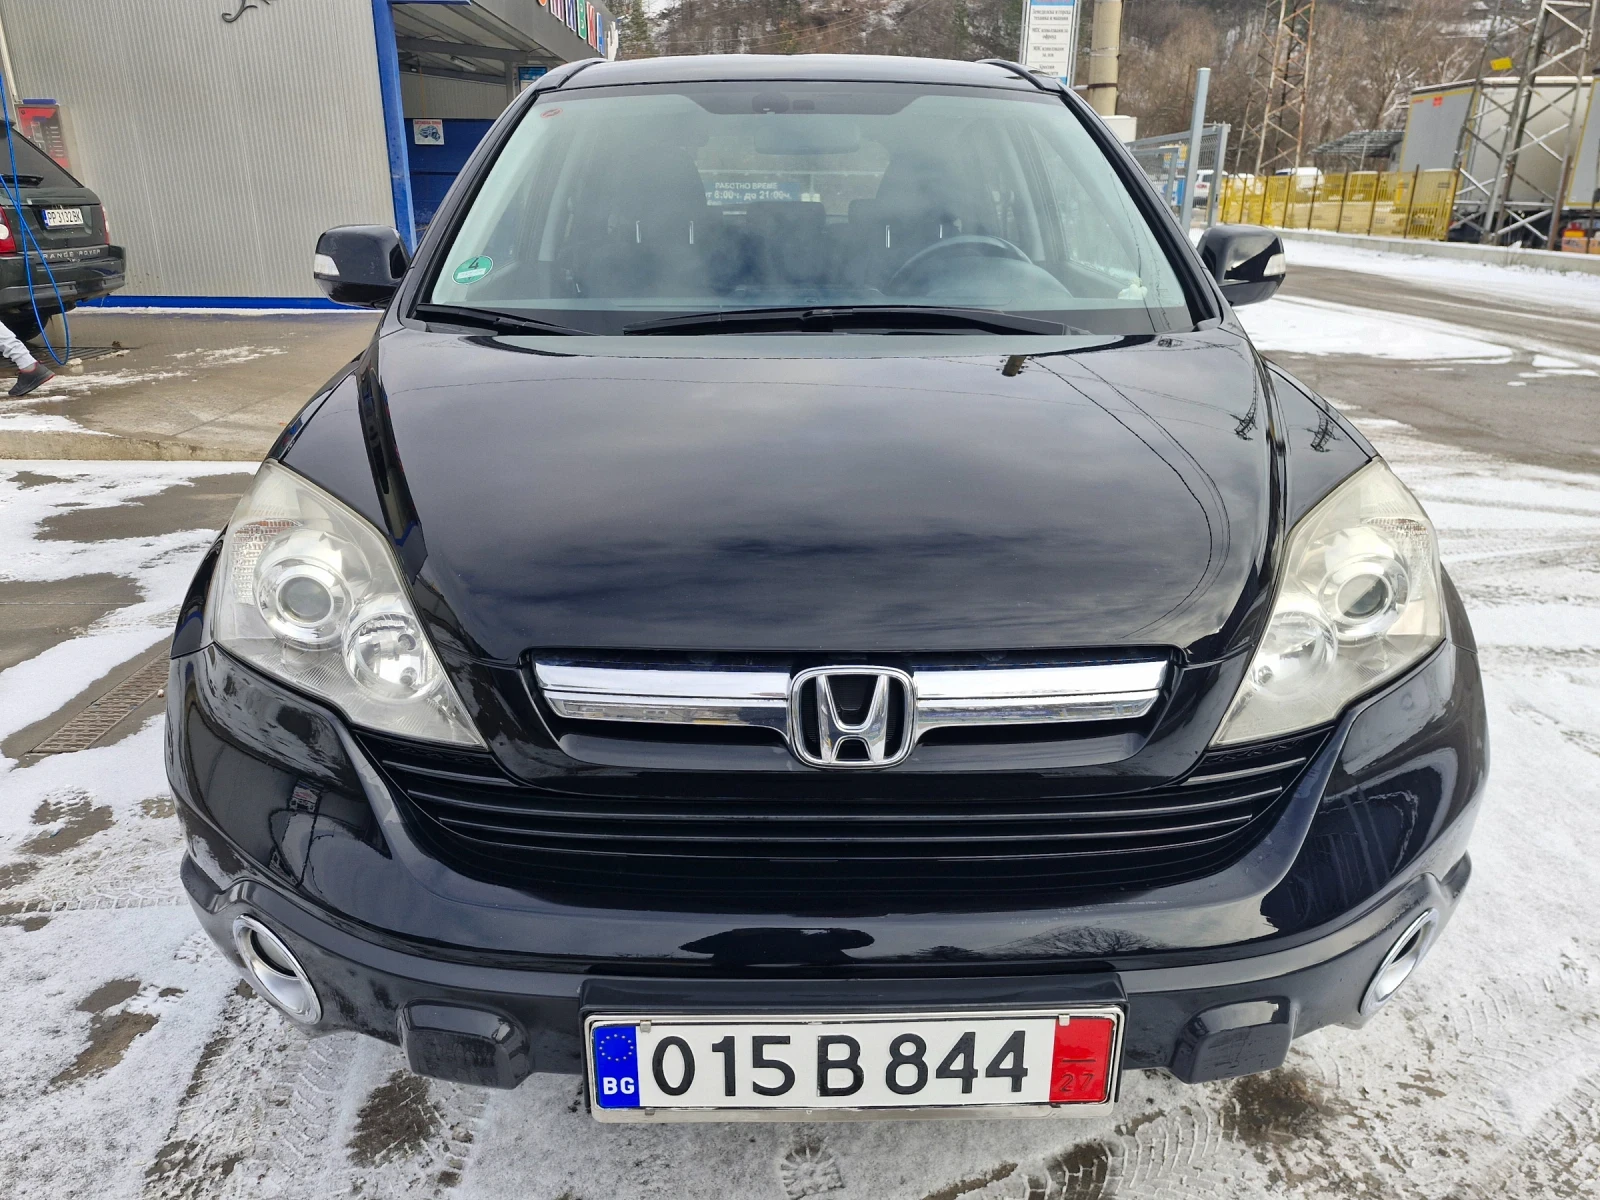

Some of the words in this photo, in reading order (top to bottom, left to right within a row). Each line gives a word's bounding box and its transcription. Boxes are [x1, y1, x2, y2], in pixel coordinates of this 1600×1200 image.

[78, 248, 101, 257] ROVER
[468, 257, 480, 270] 4
[603, 1077, 635, 1095] BG
